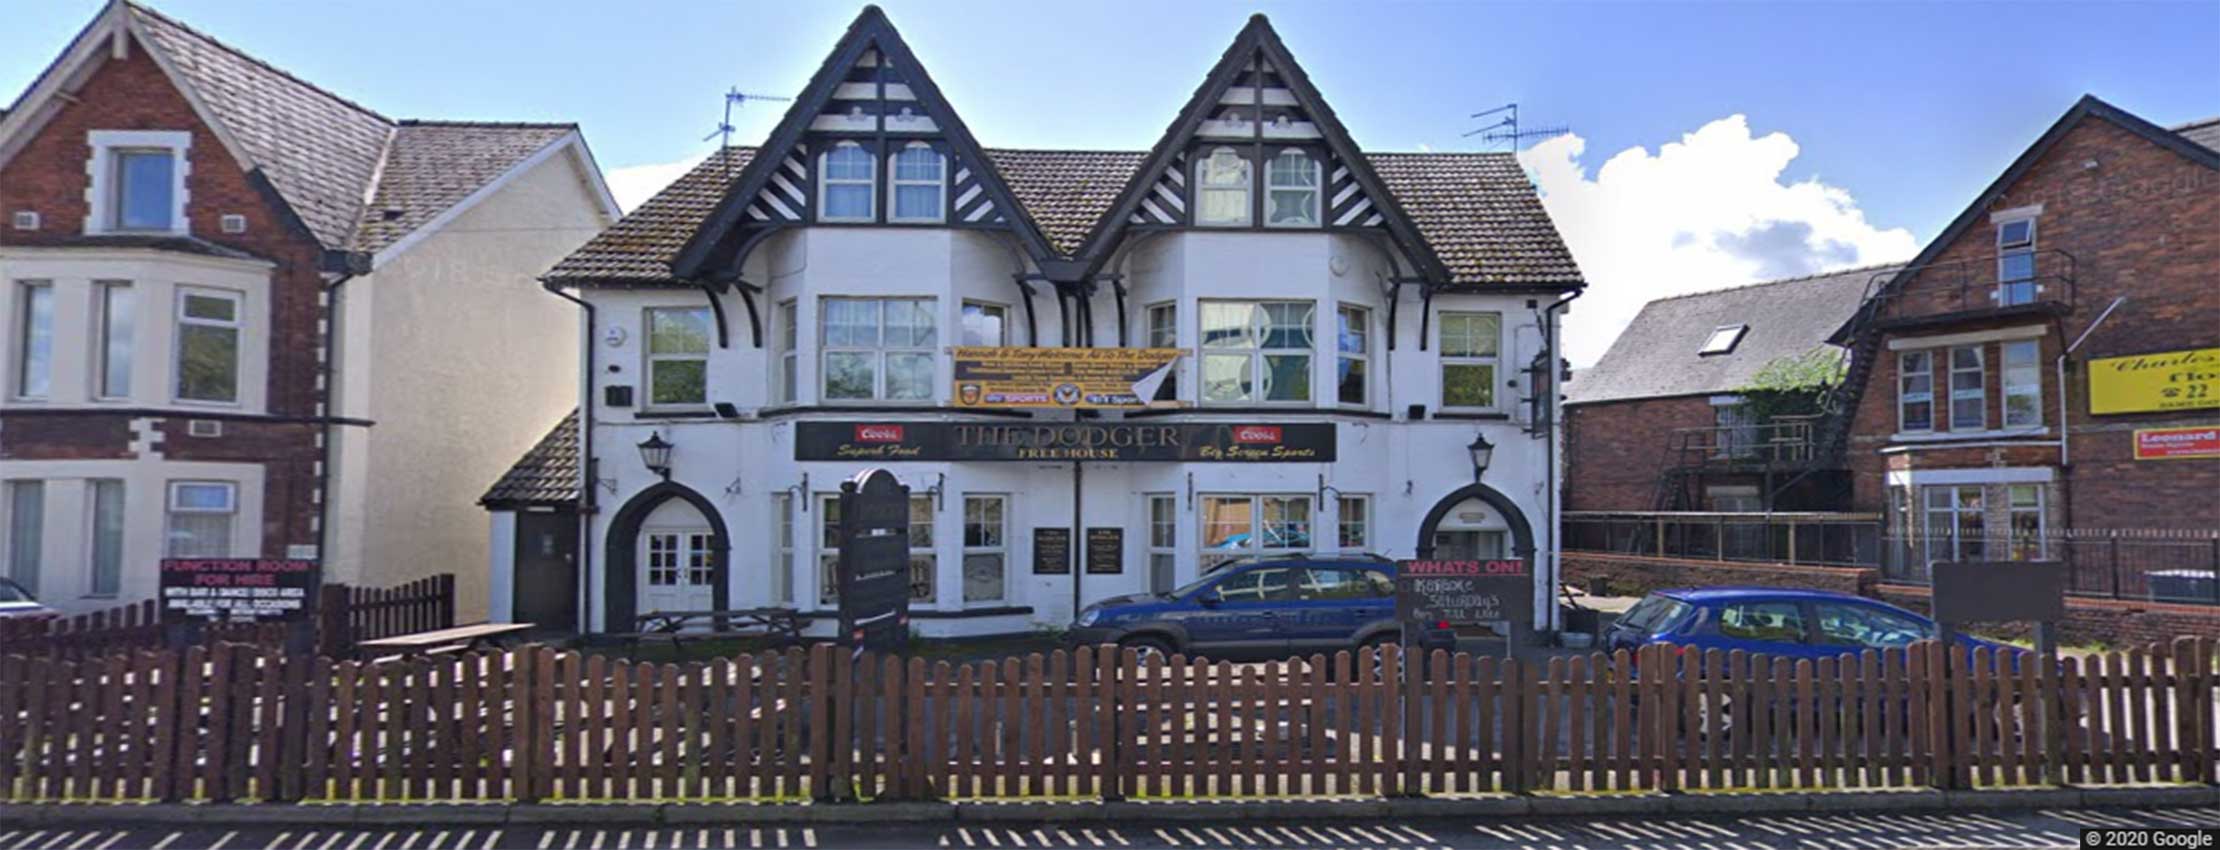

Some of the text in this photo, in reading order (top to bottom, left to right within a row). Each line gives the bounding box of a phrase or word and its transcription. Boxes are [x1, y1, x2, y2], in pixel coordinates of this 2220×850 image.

[1005, 394, 1048, 402] SPORTS
[957, 426, 1180, 446] THE DODGER
[2140, 431, 2217, 443] Leonard
[837, 443, 922, 457] Superb Food
[1017, 448, 1120, 459] FREE HOUSE
[1200, 445, 1315, 460] Big Screen Sports
[163, 560, 308, 571] FUNCTION ROOM
[1408, 561, 1522, 574] WHATS ON!
[195, 574, 275, 585] FOR HIRE
[280, 587, 304, 597] AREA
